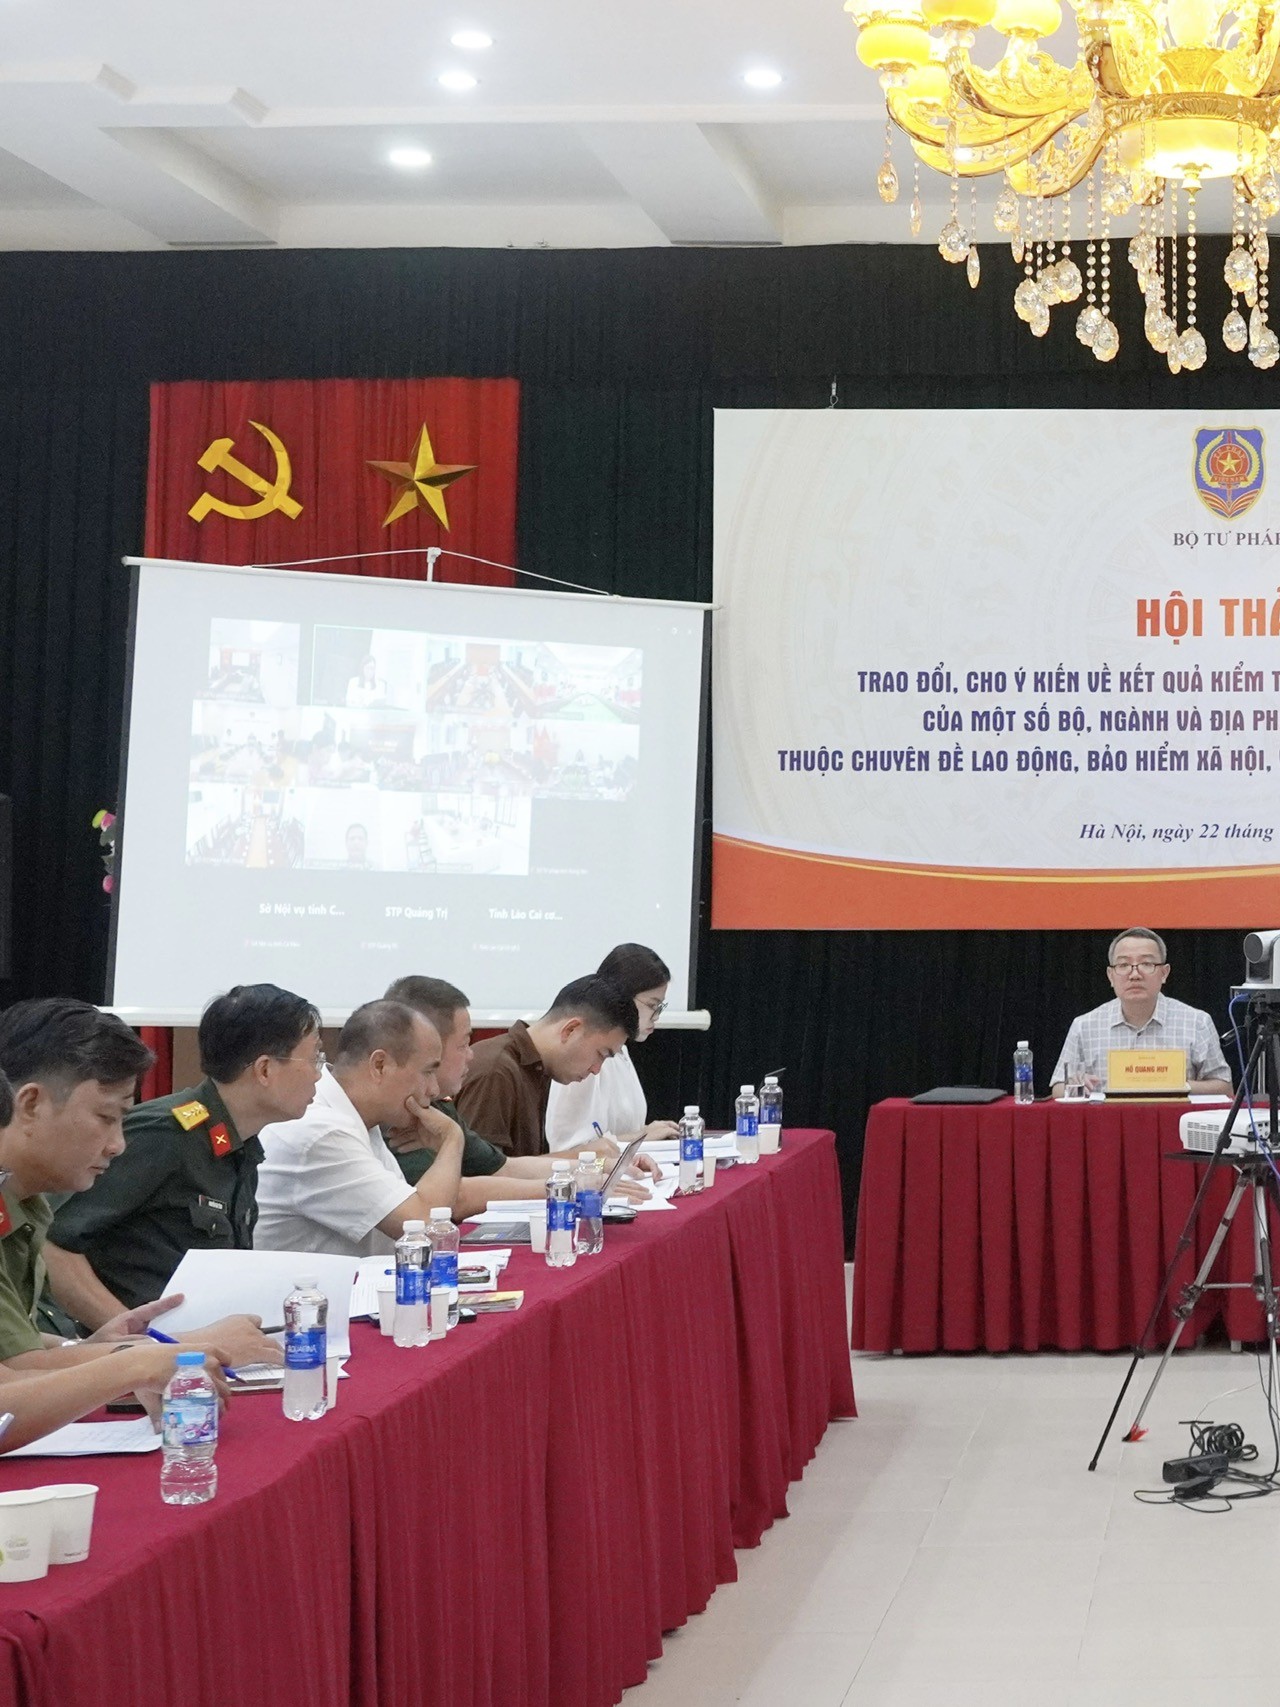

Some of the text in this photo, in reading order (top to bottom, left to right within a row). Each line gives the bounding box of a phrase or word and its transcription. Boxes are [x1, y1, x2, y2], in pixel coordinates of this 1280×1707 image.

[1174, 530, 1199, 549] BỘ
[1204, 530, 1232, 546] TƯ
[1137, 590, 1203, 645] HỘI
[858, 671, 908, 692] TRAO
[916, 662, 958, 694] ĐỔI,
[967, 671, 1006, 692] CHO
[1014, 667, 1026, 692] Ý
[1034, 663, 1079, 692] KIẾN
[1088, 663, 1111, 692] VỀ
[1120, 663, 1155, 692] KẾT
[1163, 664, 1202, 693] QUẢ
[1211, 660, 1264, 692] KIỂM
[923, 704, 962, 732] CỦA
[972, 706, 1016, 736] MỘT
[1024, 702, 1049, 732] SỐ
[1059, 706, 1091, 736] BỘ,
[1100, 706, 1168, 731] NGÀNH
[1177, 706, 1201, 731] VÀ
[1210, 710, 1244, 736] ĐỊA
[778, 746, 843, 776] THUỘC
[852, 746, 929, 771] CHUYÊN
[938, 742, 963, 771] ĐỀ
[972, 751, 1008, 771] LAO
[1016, 746, 1079, 777] ĐỘNG,
[1088, 744, 1127, 771] BẢO
[1136, 741, 1188, 771] HIỂM
[1197, 746, 1222, 771] XÃ
[1231, 746, 1271, 776] HỘI,
[1079, 823, 1105, 839] Hà
[1111, 823, 1146, 843] Nội,
[1152, 823, 1193, 843] ngày
[1199, 823, 1220, 839] 22
[1224, 823, 1274, 843] tháng
[274, 903, 291, 917] Nội
[385, 906, 402, 917] STP
[1135, 1065, 1155, 1073] QUANG
[1156, 1065, 1168, 1073] HUY
